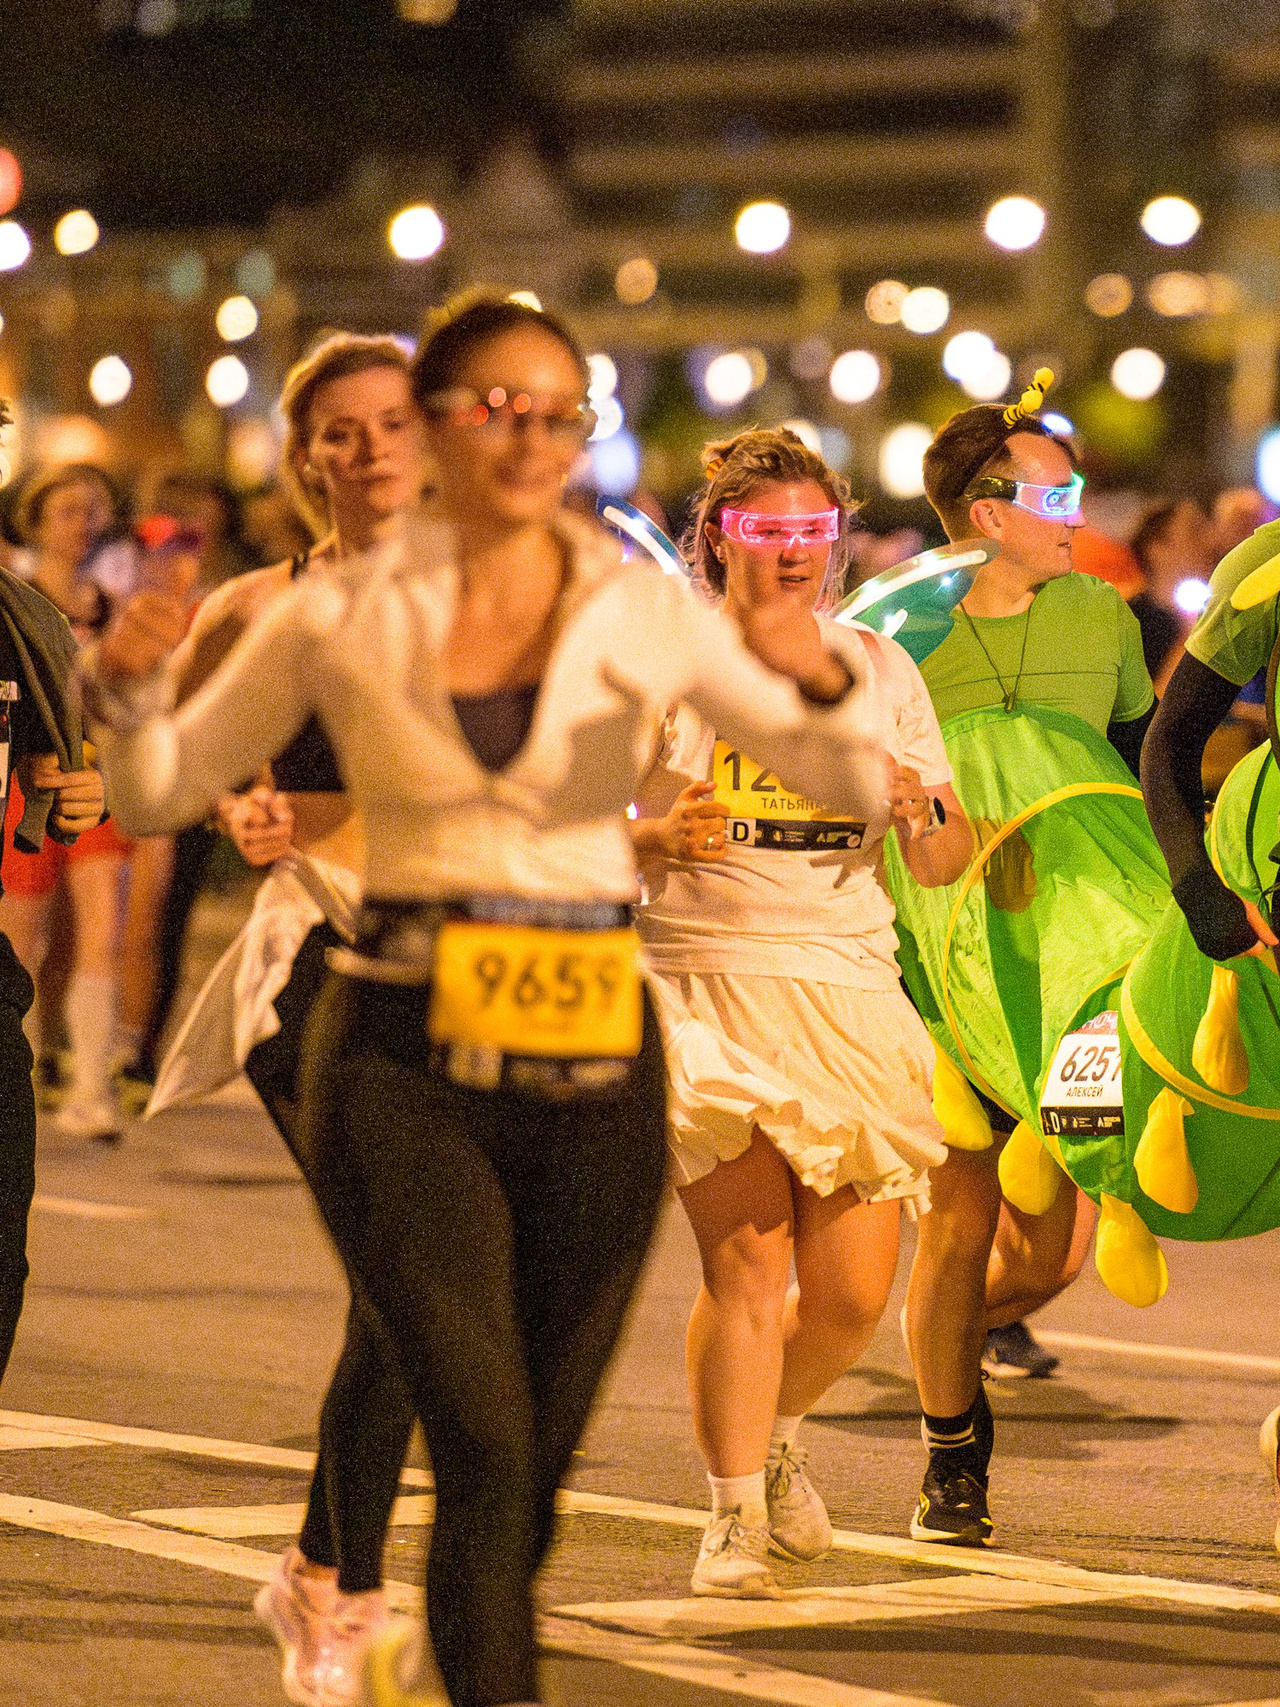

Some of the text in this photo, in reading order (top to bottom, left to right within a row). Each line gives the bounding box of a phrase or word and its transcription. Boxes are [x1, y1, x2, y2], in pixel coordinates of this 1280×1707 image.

[732, 821, 749, 842] D
[1066, 1084, 1104, 1098] АЛЕКСЕЙ
[1050, 1111, 1060, 1133] D
